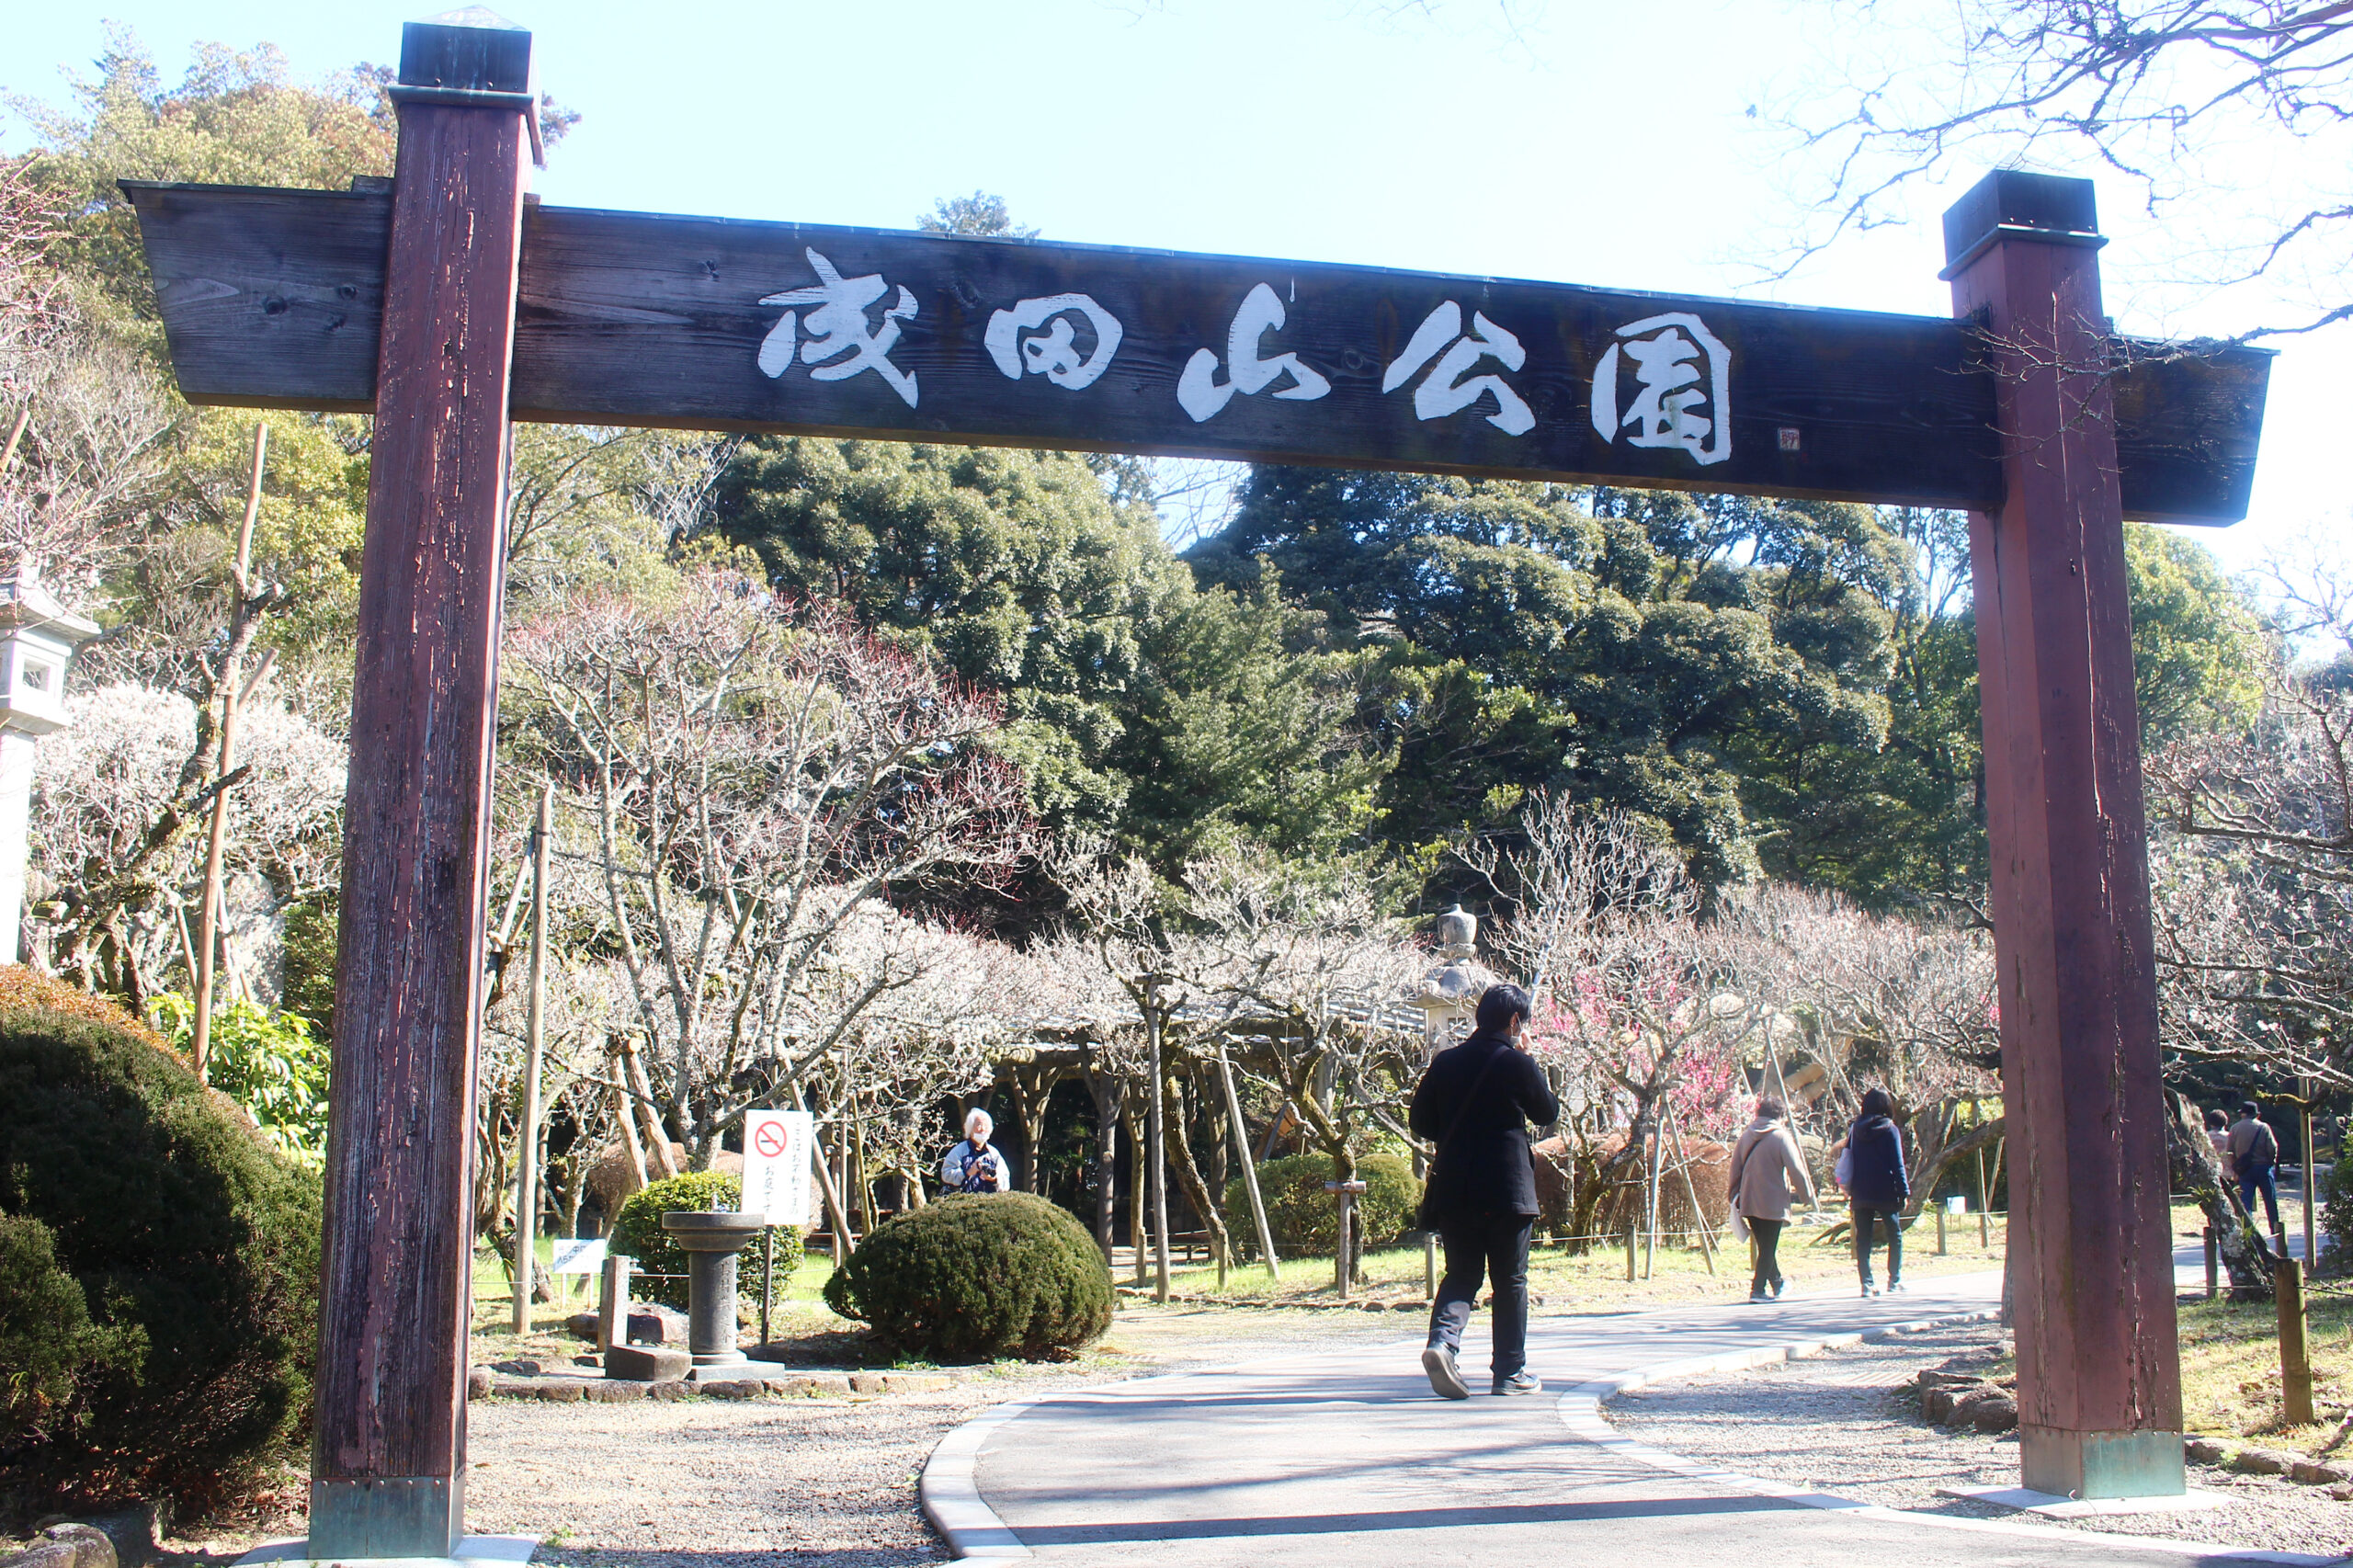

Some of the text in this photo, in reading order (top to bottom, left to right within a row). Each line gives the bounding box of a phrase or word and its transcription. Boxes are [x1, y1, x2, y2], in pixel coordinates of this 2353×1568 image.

[757, 245, 1733, 465] 成田山公園
[763, 1165, 775, 1214] お庭です
